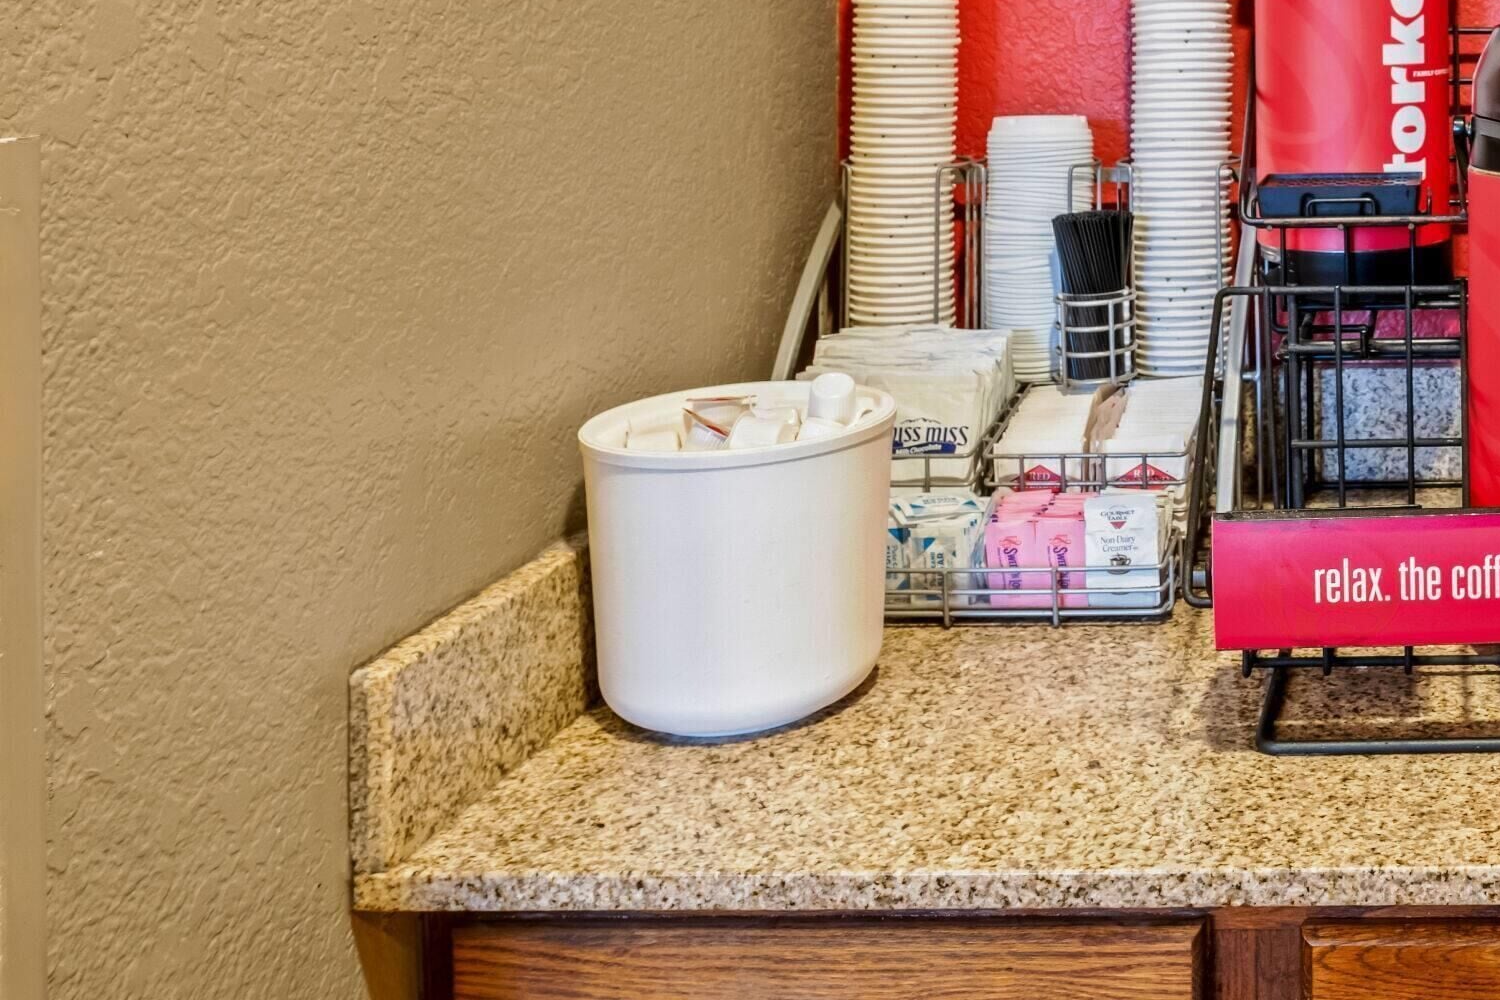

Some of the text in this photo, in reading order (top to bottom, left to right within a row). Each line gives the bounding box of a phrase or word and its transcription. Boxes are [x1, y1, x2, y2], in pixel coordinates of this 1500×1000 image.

[1028, 471, 1050, 481] RED
[1102, 544, 1132, 552] Creamer
[1314, 558, 1391, 603] relax.
[1399, 557, 1441, 601] the
